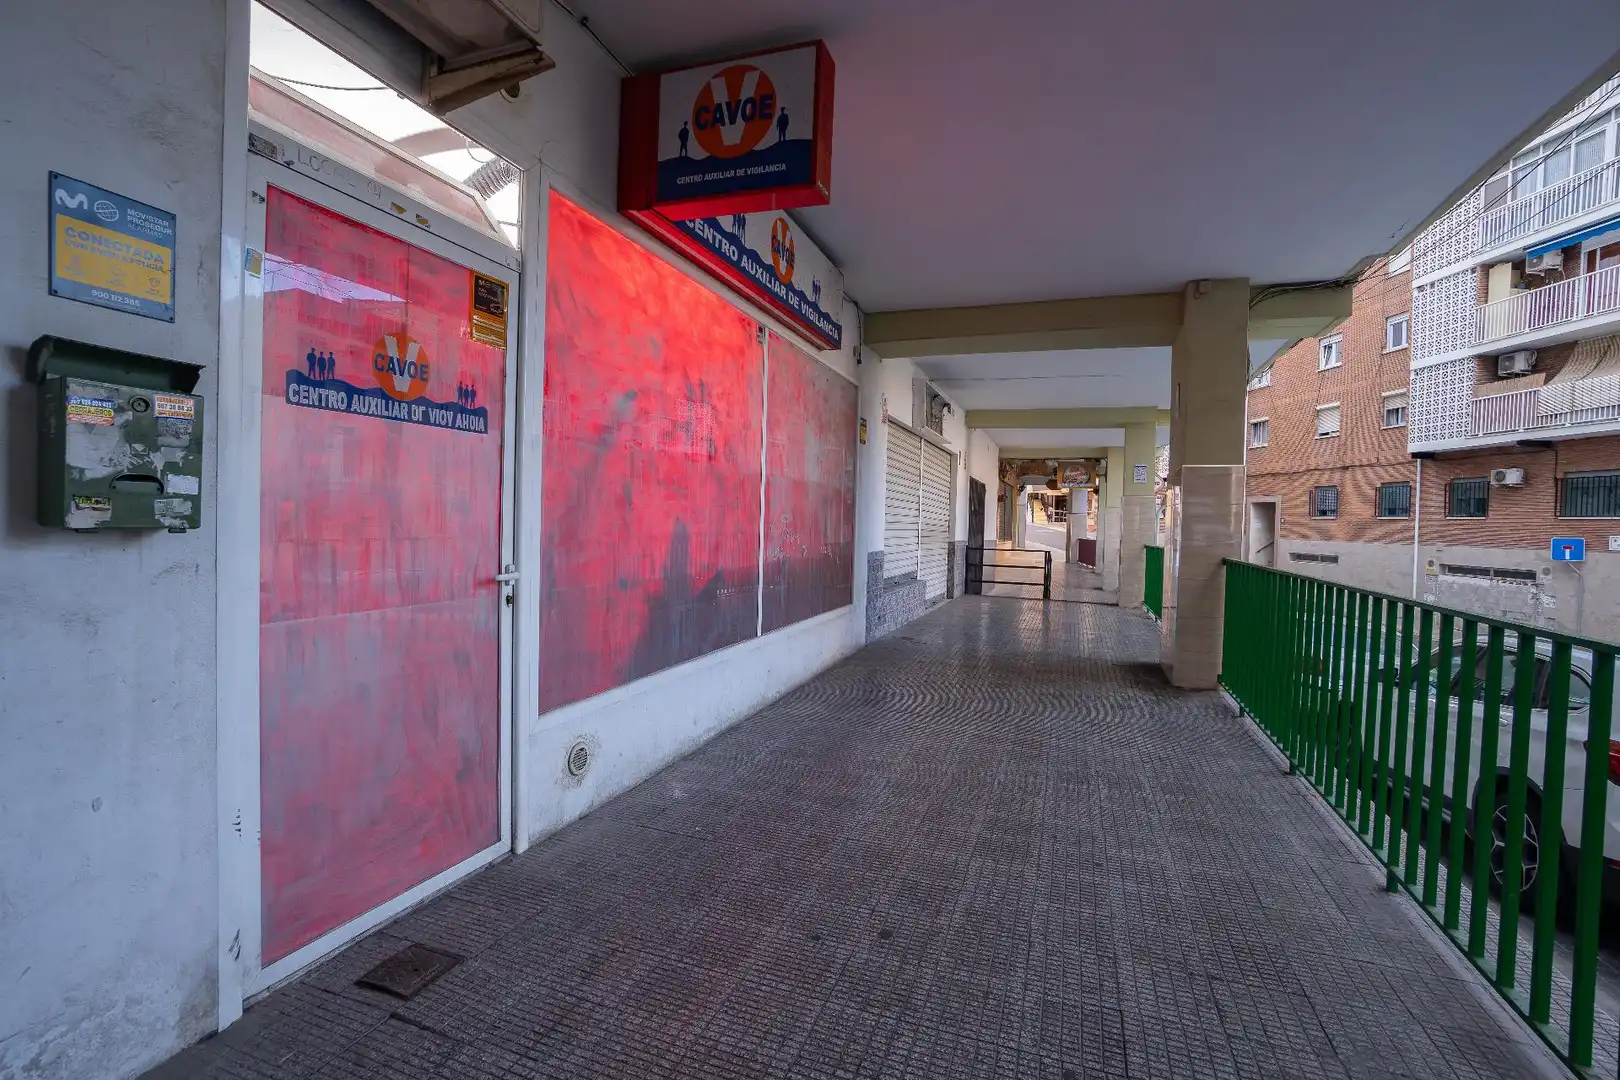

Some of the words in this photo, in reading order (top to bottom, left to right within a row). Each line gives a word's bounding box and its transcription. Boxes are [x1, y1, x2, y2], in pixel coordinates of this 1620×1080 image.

[695, 93, 774, 131] CAVOE
[676, 174, 703, 184] CENTRO
[703, 169, 735, 181] AUXILIAR
[736, 168, 746, 176] DE
[746, 162, 787, 175] VIGILANCIA
[127, 208, 169, 228] MOVISTAR
[127, 215, 173, 236] PROSEGUR
[64, 226, 165, 265] CONECTADA
[686, 219, 739, 261] CENTRO
[740, 253, 787, 300] AUXILIAR
[788, 291, 799, 310] DE
[800, 302, 839, 341] VIGILANCIA
[374, 353, 429, 382] CAVOE
[288, 383, 348, 409] CENTRO
[351, 394, 408, 420] AUXILIAR
